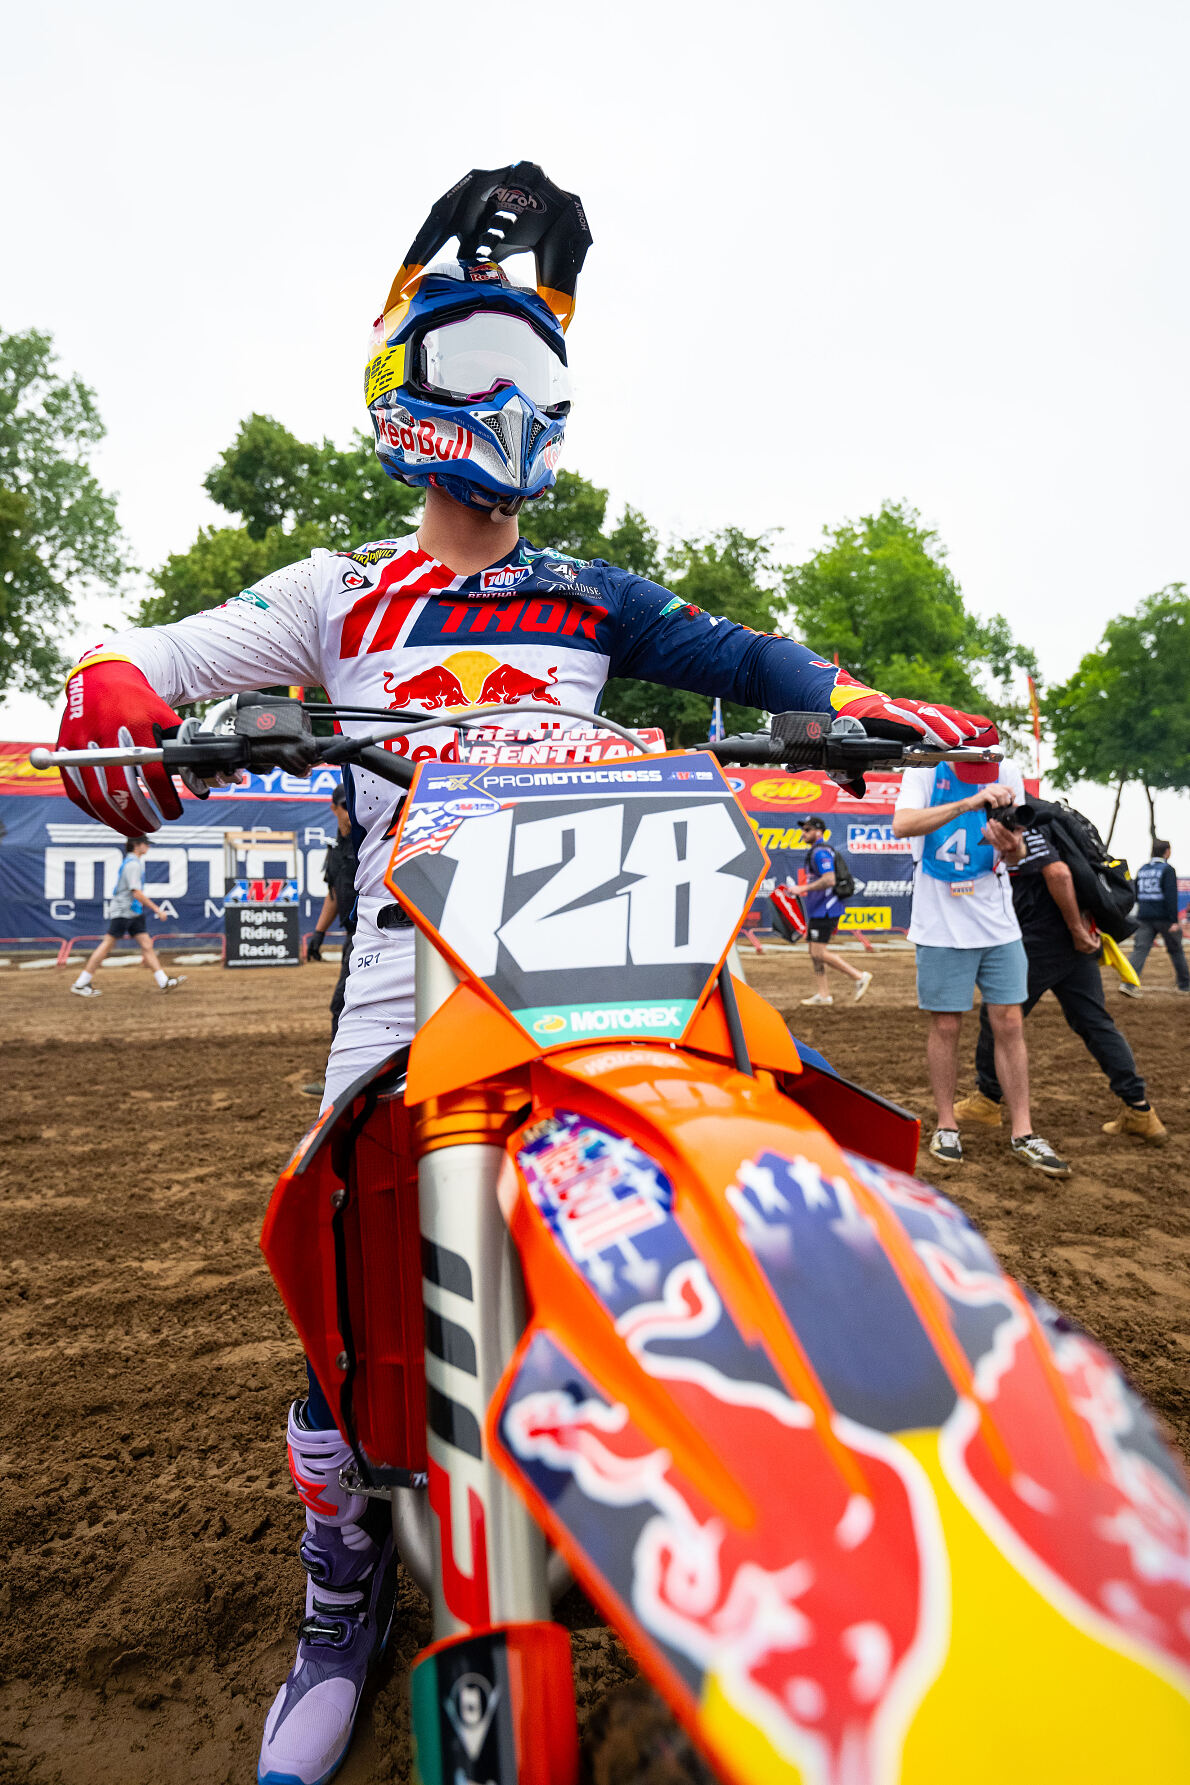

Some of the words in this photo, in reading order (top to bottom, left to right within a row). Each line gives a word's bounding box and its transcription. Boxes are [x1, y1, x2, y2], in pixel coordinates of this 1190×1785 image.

[491, 187, 538, 209] Airoh
[574, 201, 588, 231] AIROH
[416, 418, 474, 462] Bull
[488, 570, 527, 587] 100%
[468, 591, 519, 599] RENTHAL
[438, 599, 609, 640] THOR
[69, 673, 85, 720] THOR
[935, 828, 970, 871] 4
[439, 802, 750, 979] 128
[240, 909, 288, 926] Rights.
[240, 926, 288, 942] Riding.
[239, 943, 289, 959] Racing.
[570, 1007, 682, 1031] MOTOREX
